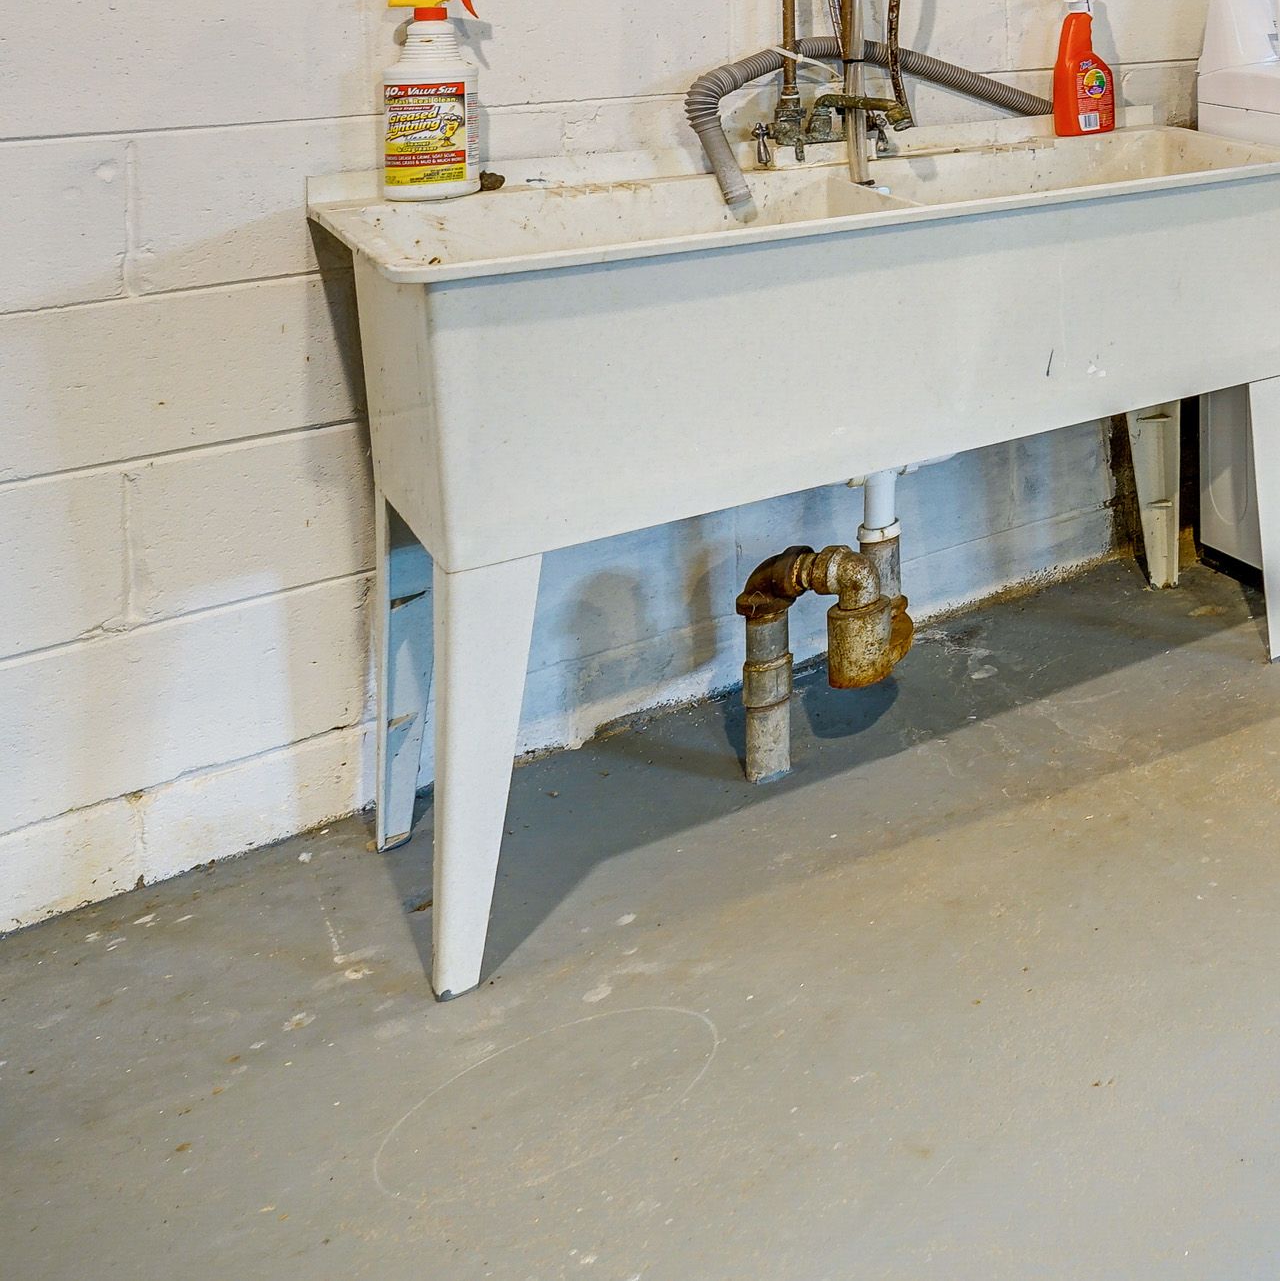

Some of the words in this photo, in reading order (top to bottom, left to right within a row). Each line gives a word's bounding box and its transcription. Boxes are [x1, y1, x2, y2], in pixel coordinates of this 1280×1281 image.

[407, 87, 437, 96] VALUE
[388, 105, 440, 124] Greased
[386, 119, 441, 135] Lightning
